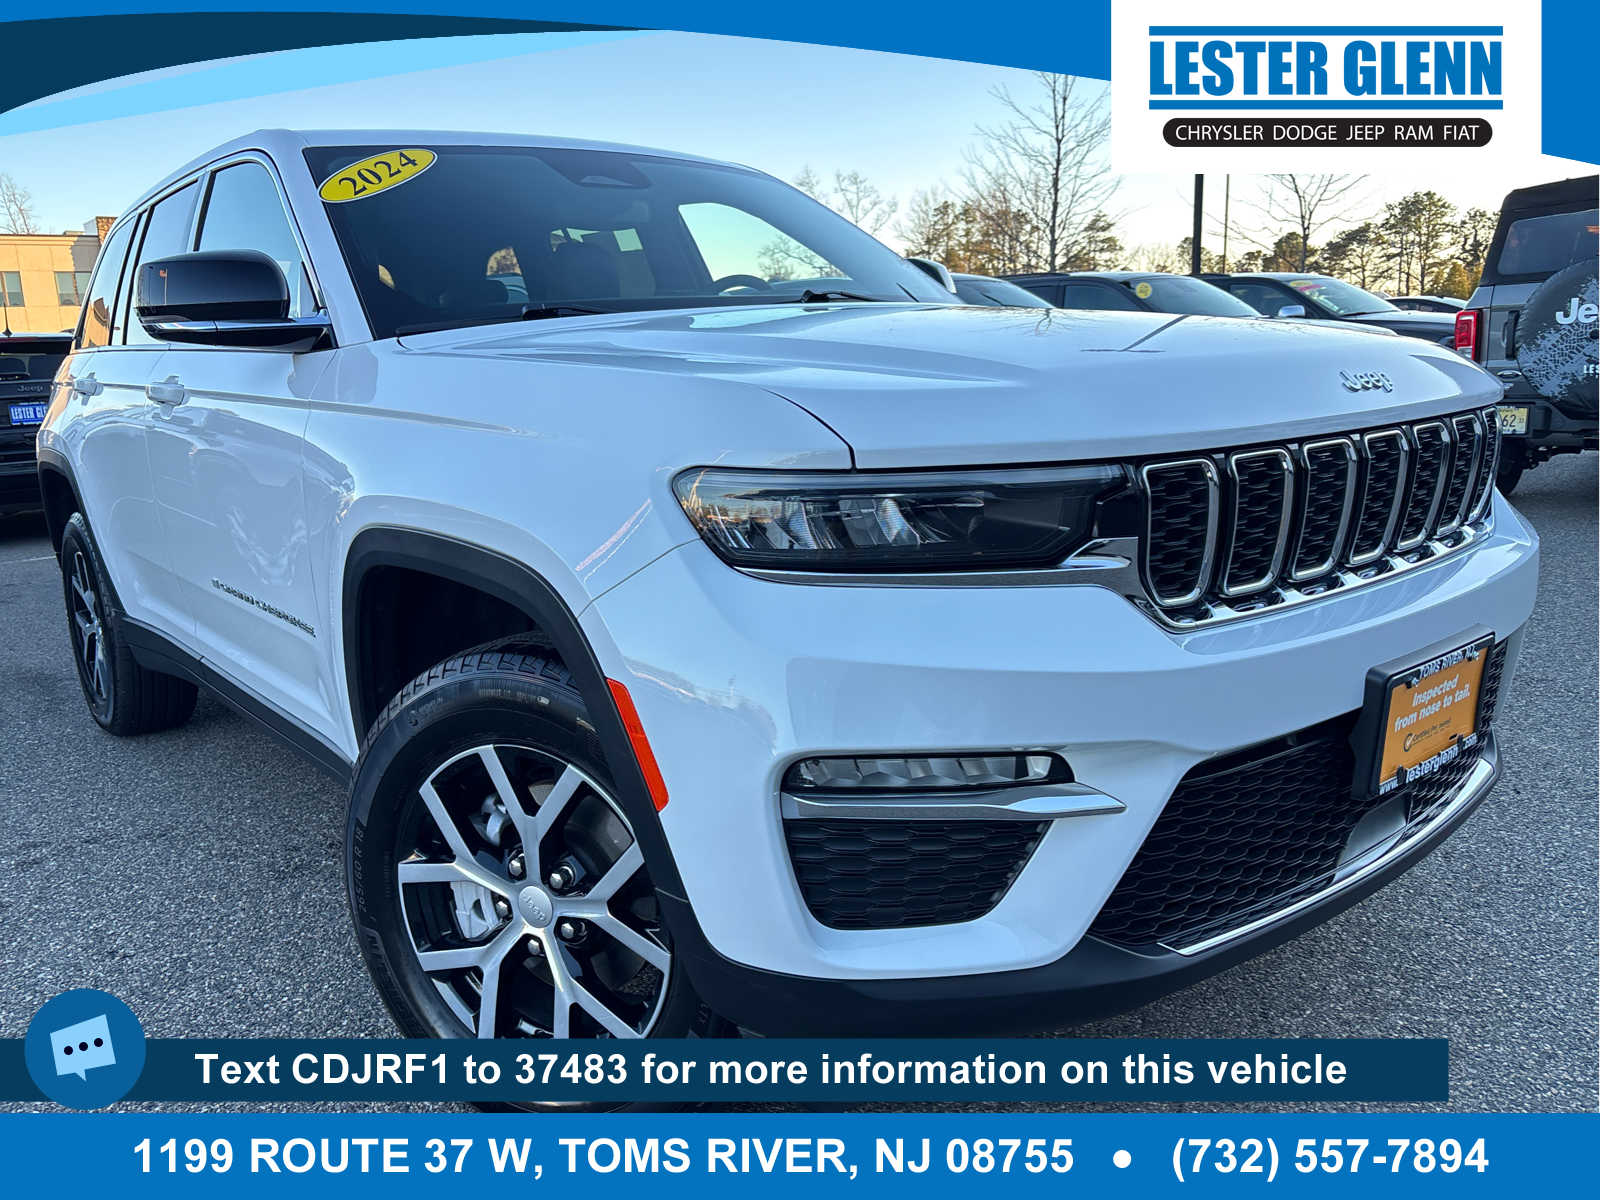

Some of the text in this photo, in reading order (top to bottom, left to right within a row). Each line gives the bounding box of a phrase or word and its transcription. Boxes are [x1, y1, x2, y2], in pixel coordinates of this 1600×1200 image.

[338, 151, 418, 196] 2024
[1340, 371, 1393, 393] Jeep
[10, 407, 35, 420] LESTER
[1412, 674, 1459, 707] Inspected
[1394, 711, 1418, 732] from
[1418, 701, 1441, 721] nose
[1442, 695, 1453, 708] to
